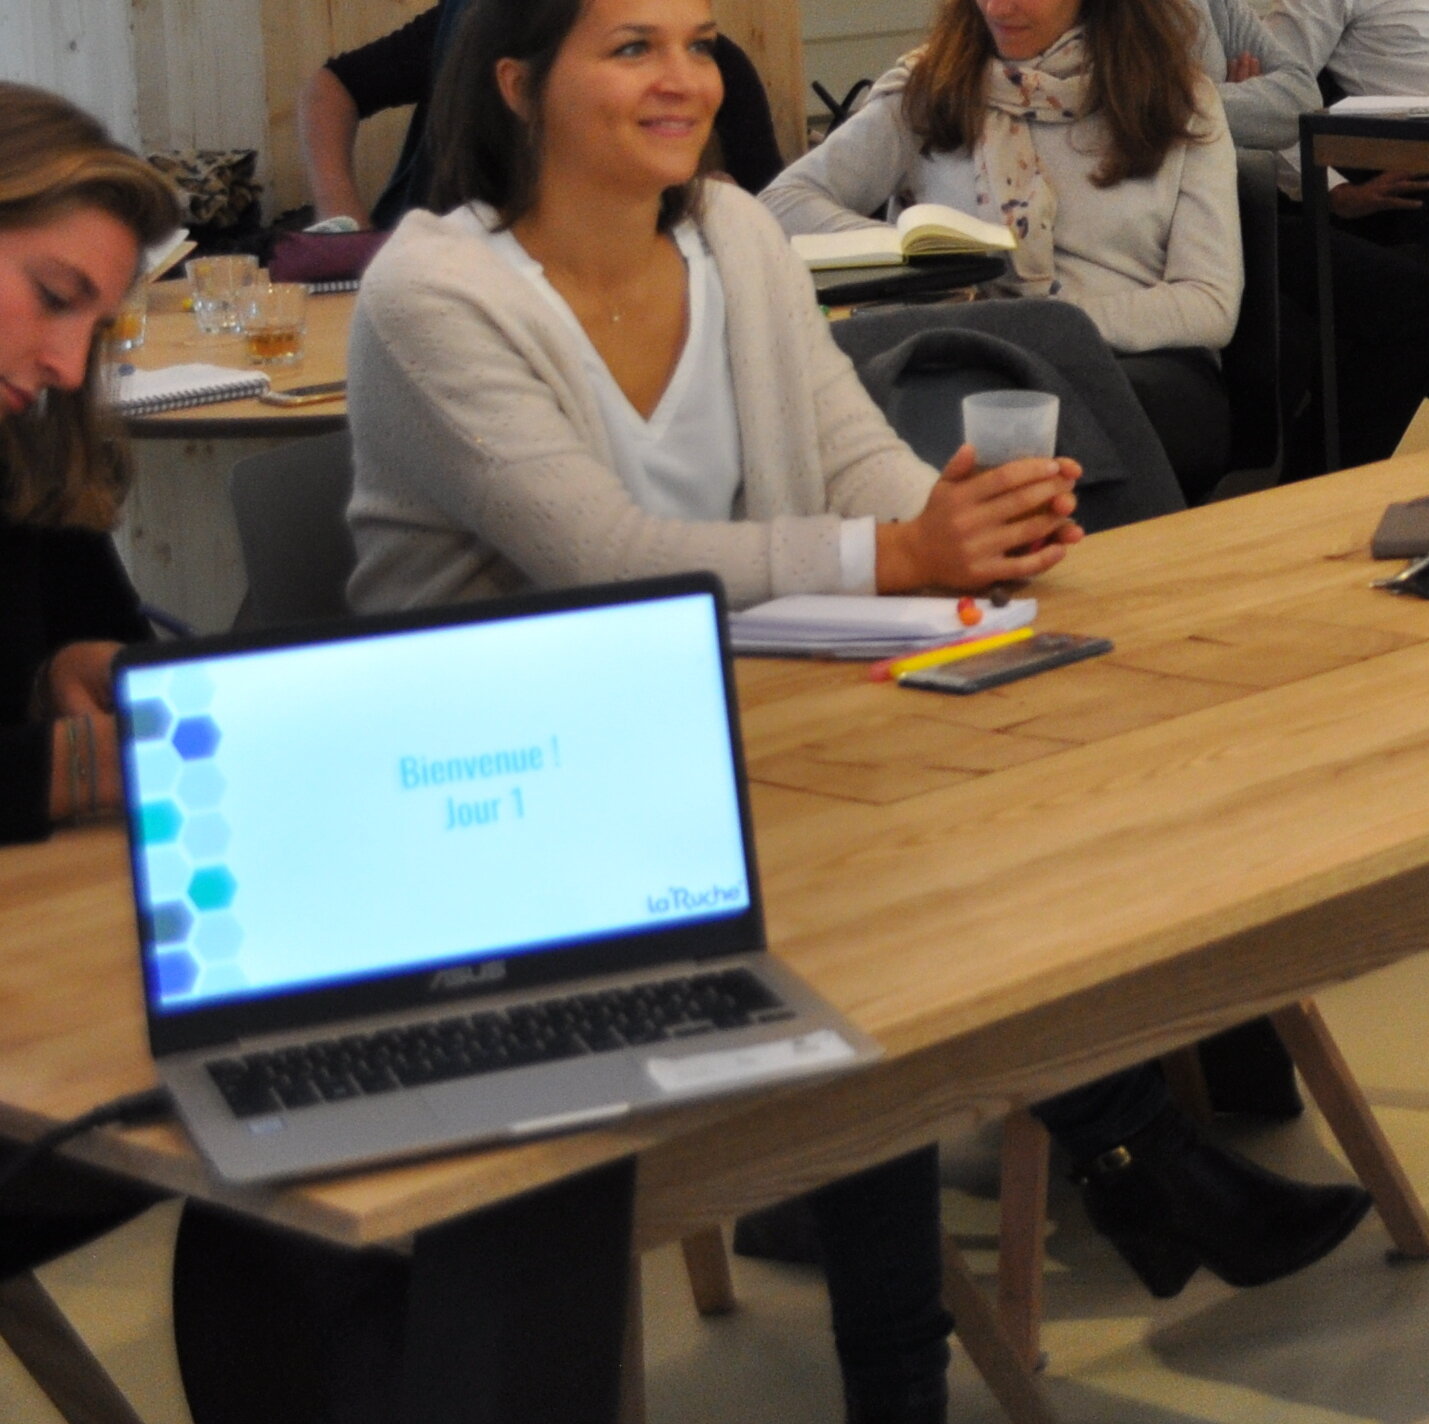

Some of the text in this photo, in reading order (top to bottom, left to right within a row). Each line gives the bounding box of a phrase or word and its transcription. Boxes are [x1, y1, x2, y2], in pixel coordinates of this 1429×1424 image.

[399, 733, 561, 791] Bienvenue !
[445, 785, 525, 831] Jour 1
